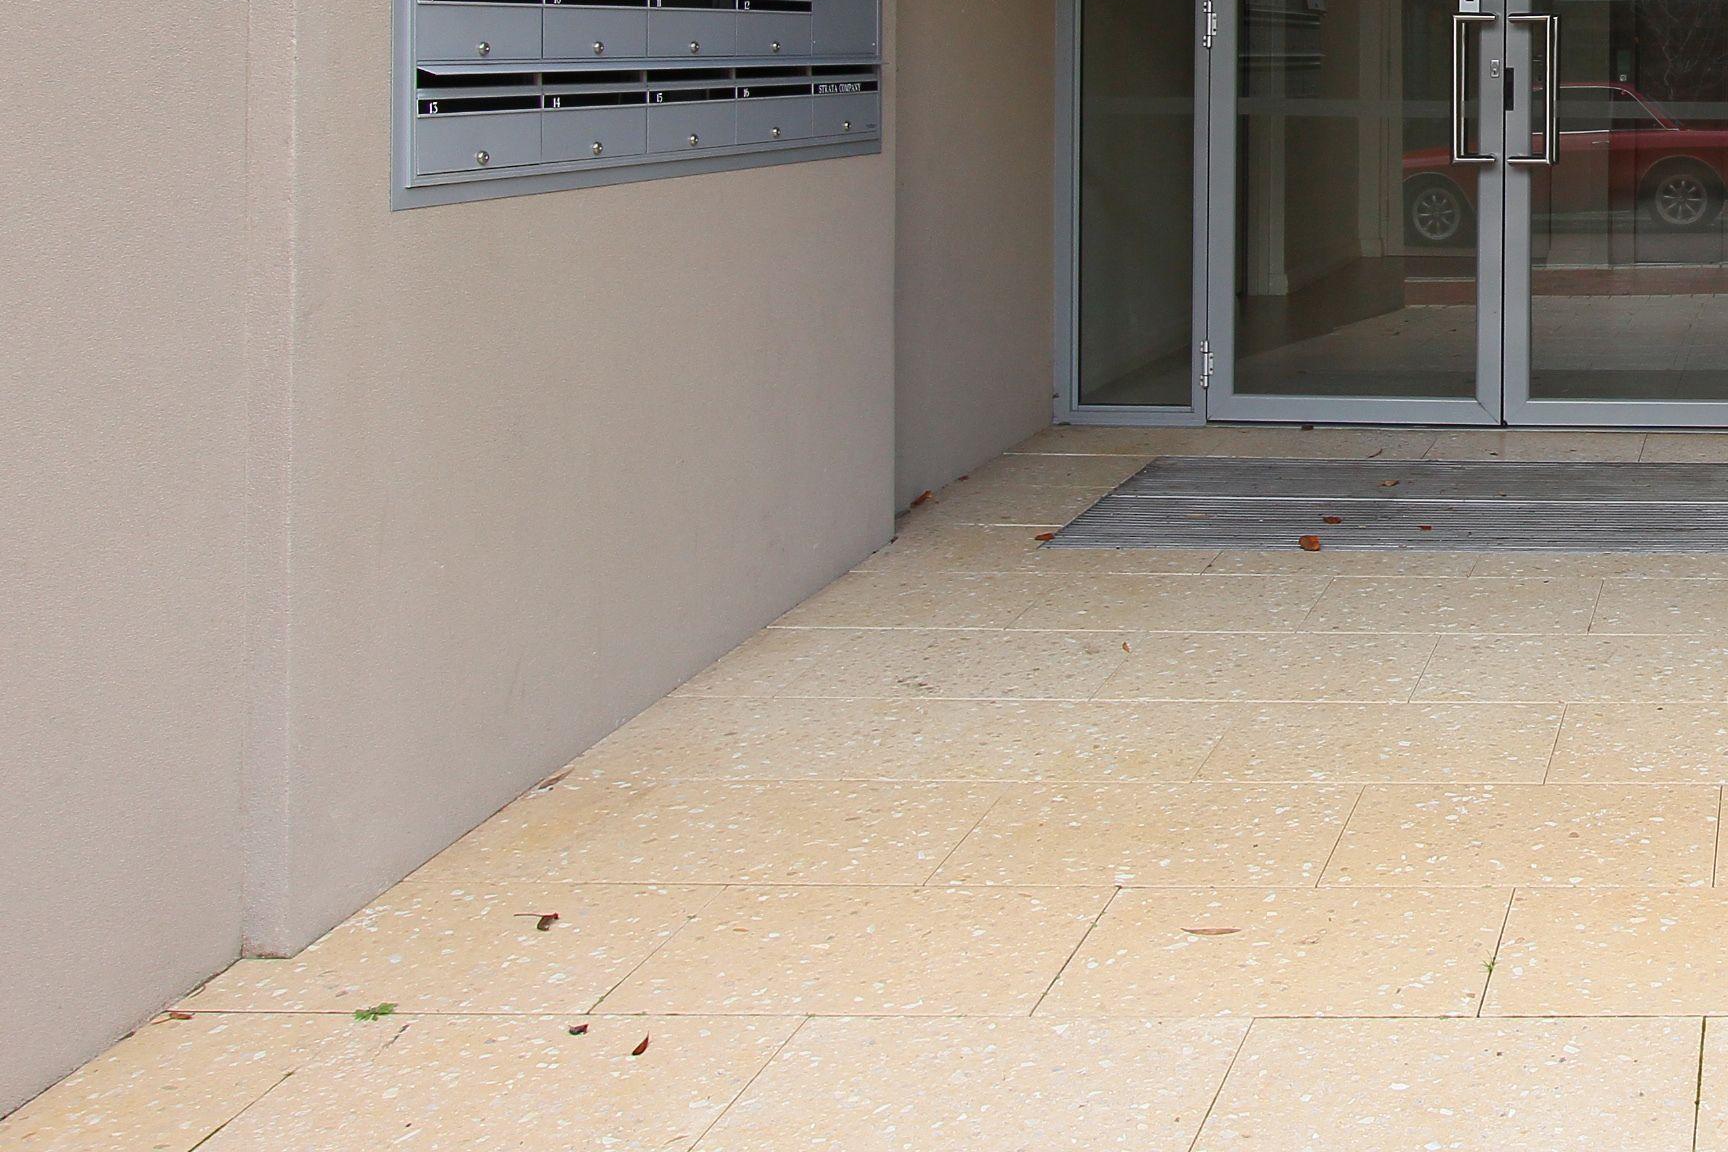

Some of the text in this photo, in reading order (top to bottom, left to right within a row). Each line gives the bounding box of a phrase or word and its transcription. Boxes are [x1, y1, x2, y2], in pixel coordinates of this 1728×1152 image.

[744, 0, 750, 10] 12
[818, 83, 861, 94] STRATA COMPANY
[553, 97, 561, 108] 14
[656, 92, 663, 103] 15
[429, 101, 439, 114] 13
